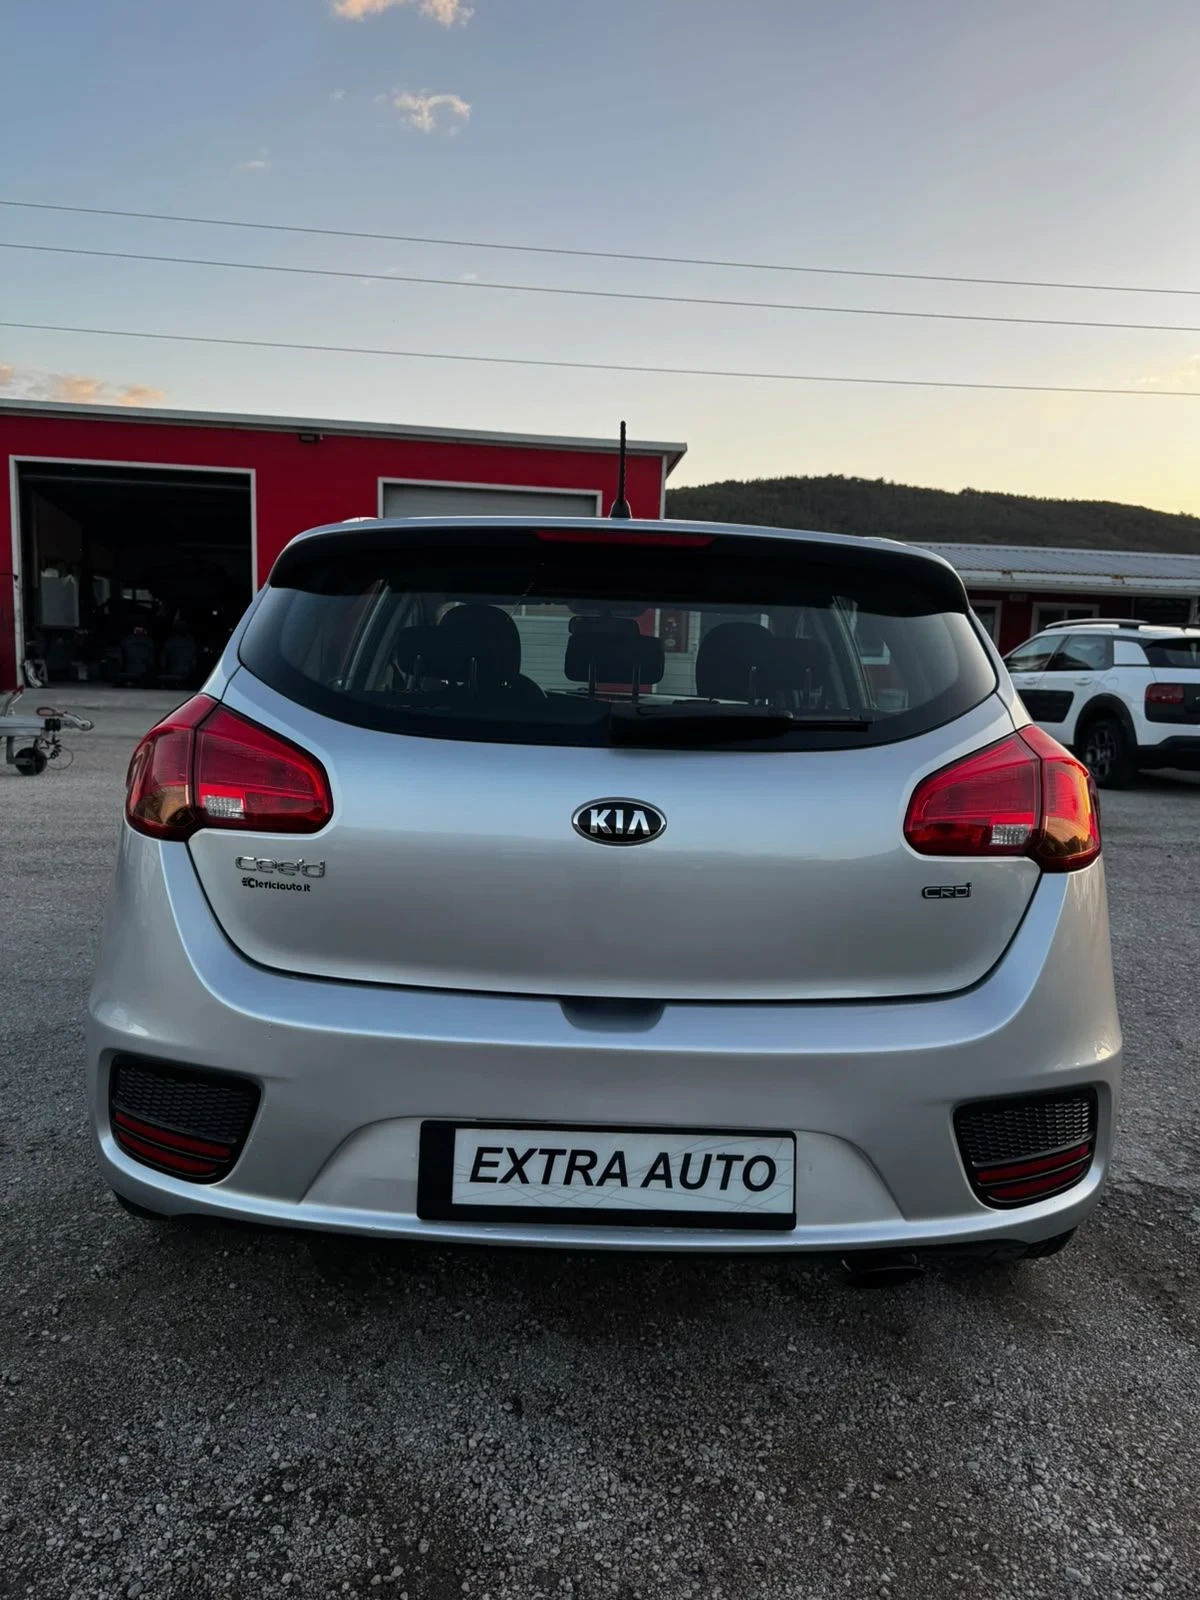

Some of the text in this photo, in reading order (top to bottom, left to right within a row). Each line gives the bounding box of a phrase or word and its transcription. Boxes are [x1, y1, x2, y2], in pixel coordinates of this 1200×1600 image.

[590, 809, 650, 834] KIA
[469, 1146, 777, 1193] EXTRA AUTO
